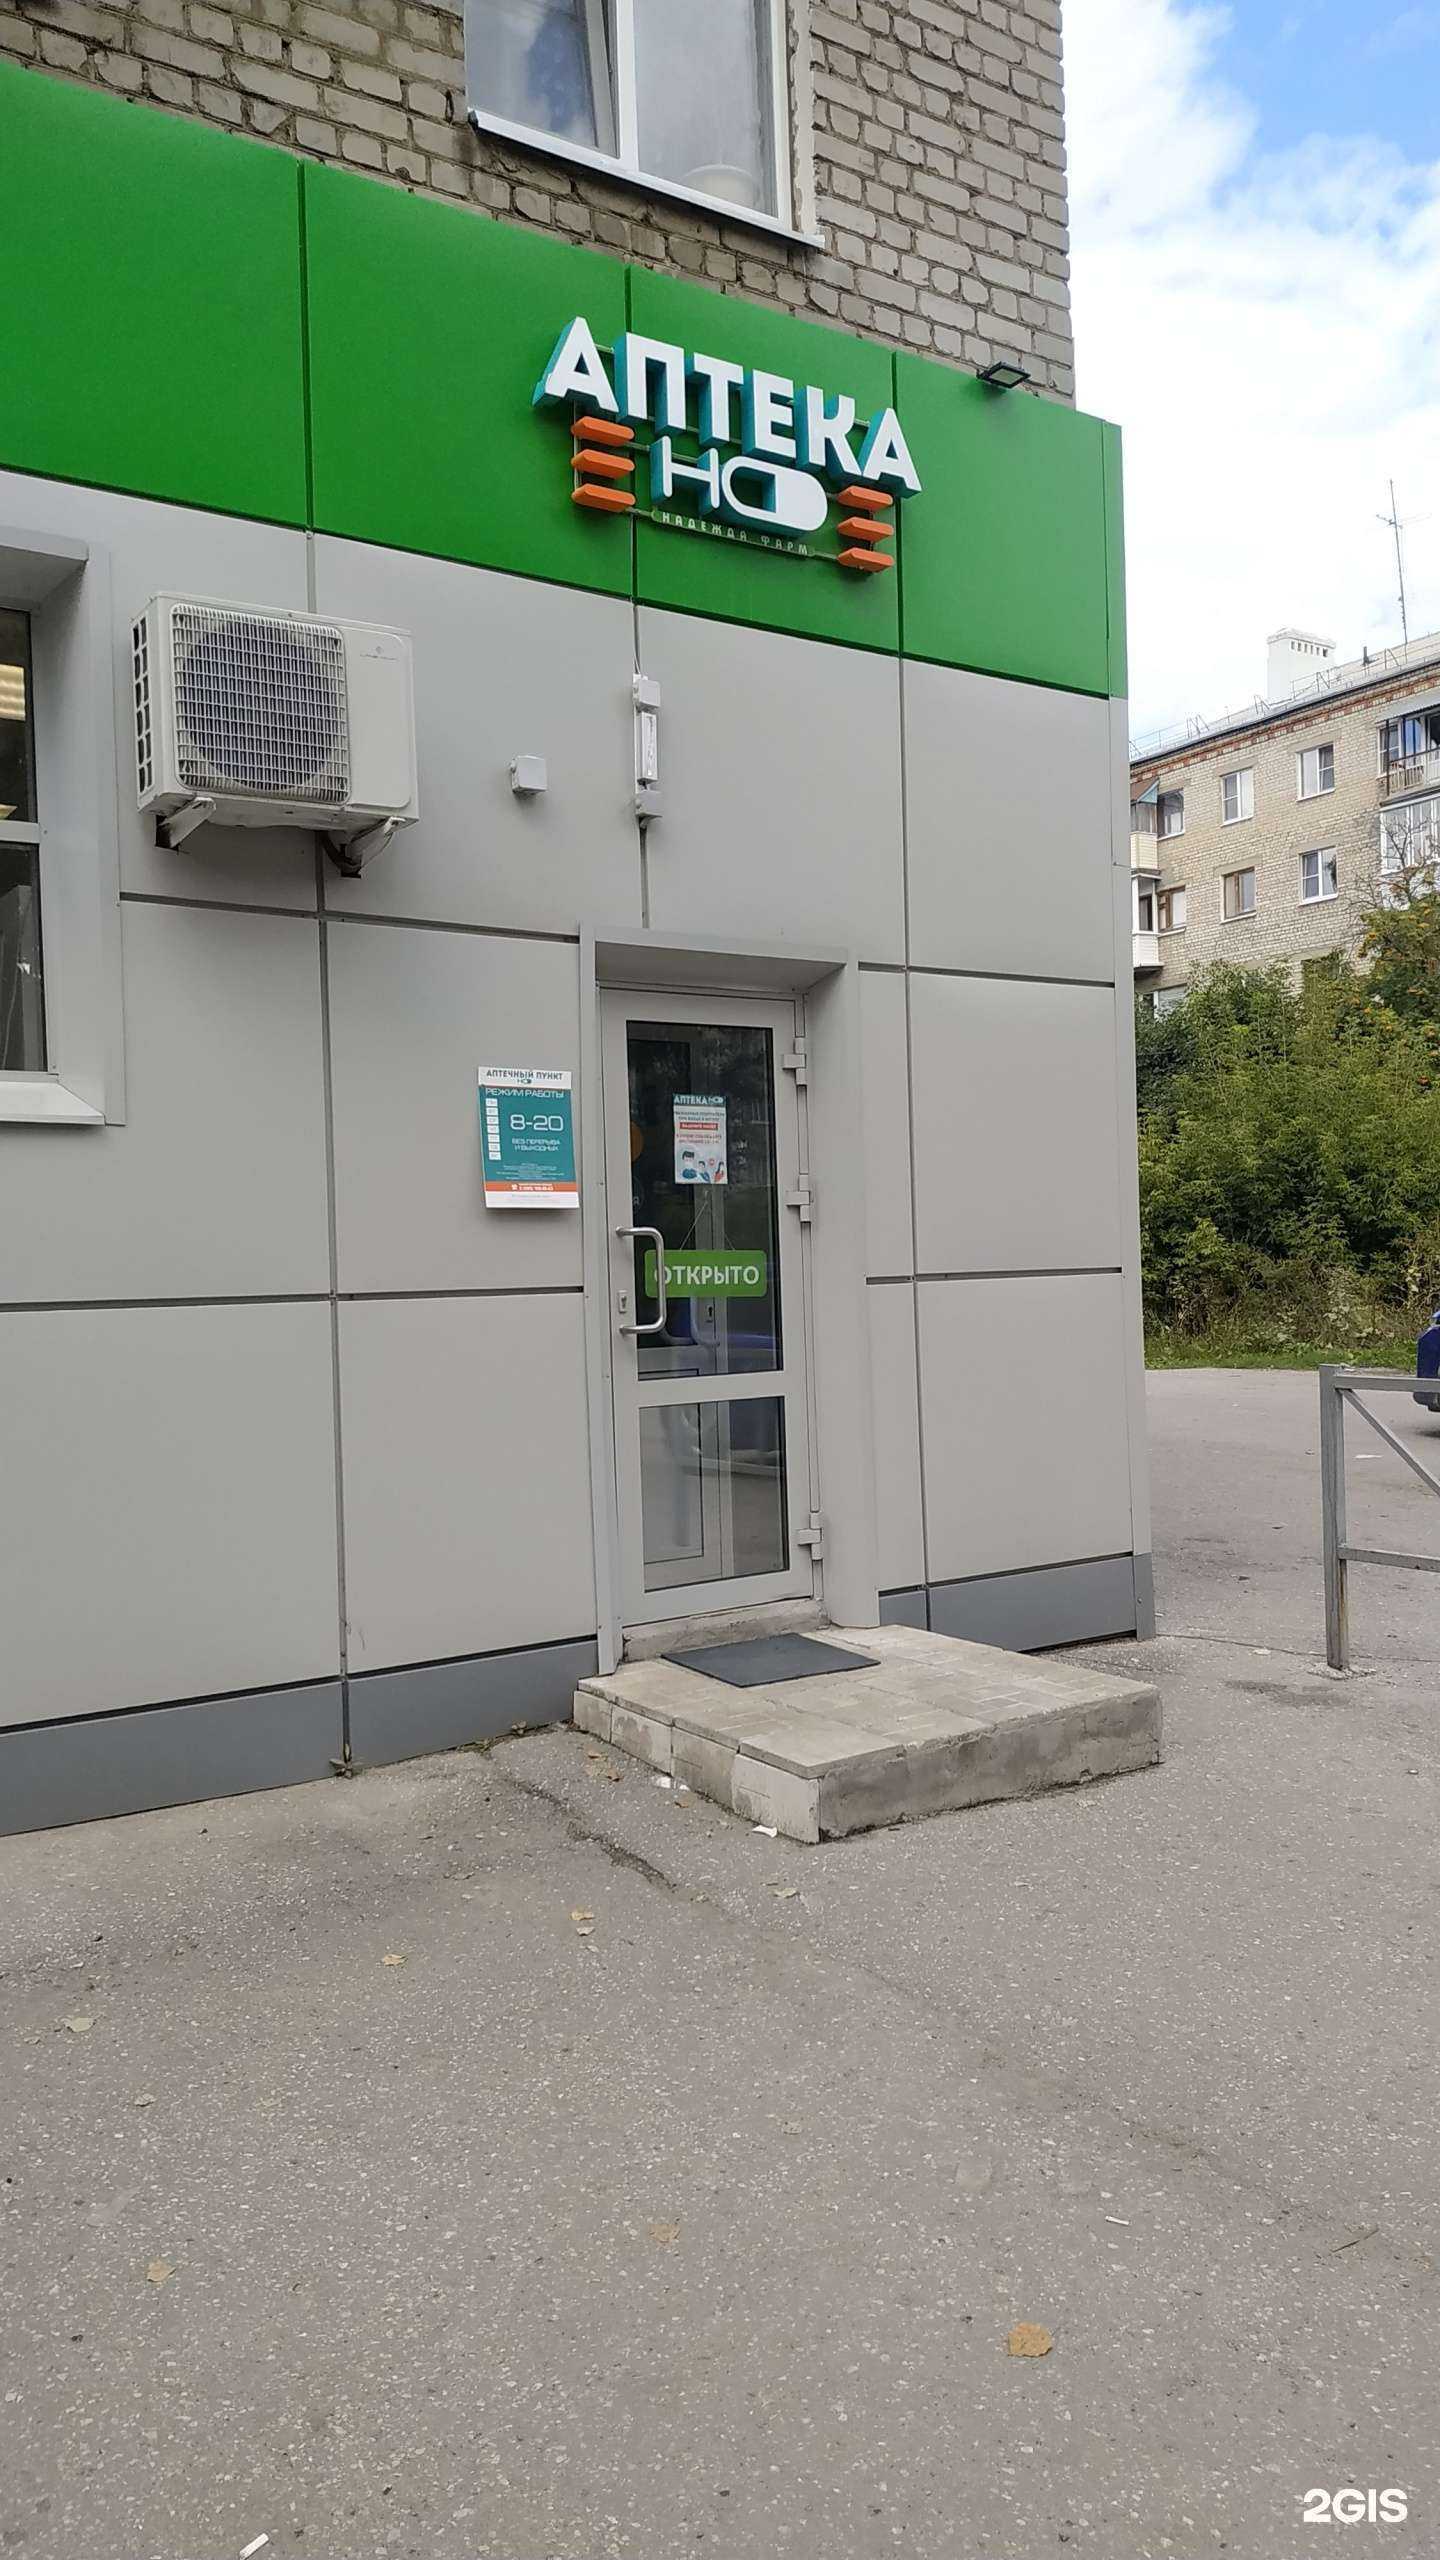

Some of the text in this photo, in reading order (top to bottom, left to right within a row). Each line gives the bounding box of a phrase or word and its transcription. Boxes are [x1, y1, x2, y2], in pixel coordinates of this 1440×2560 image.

[539, 316, 922, 494] АПТЕКА
[662, 511, 808, 555] НАДЕЖДА ФАРМ
[486, 1069, 563, 1080] АПТЕЧНЫЙ ПУНКТ
[485, 1088, 564, 1098] РЕЖИМ РАБОТЫ
[674, 1095, 708, 1105] АПТЕКА
[510, 1114, 563, 1131] 8-20
[654, 1265, 760, 1285] ОТКРЫТО
